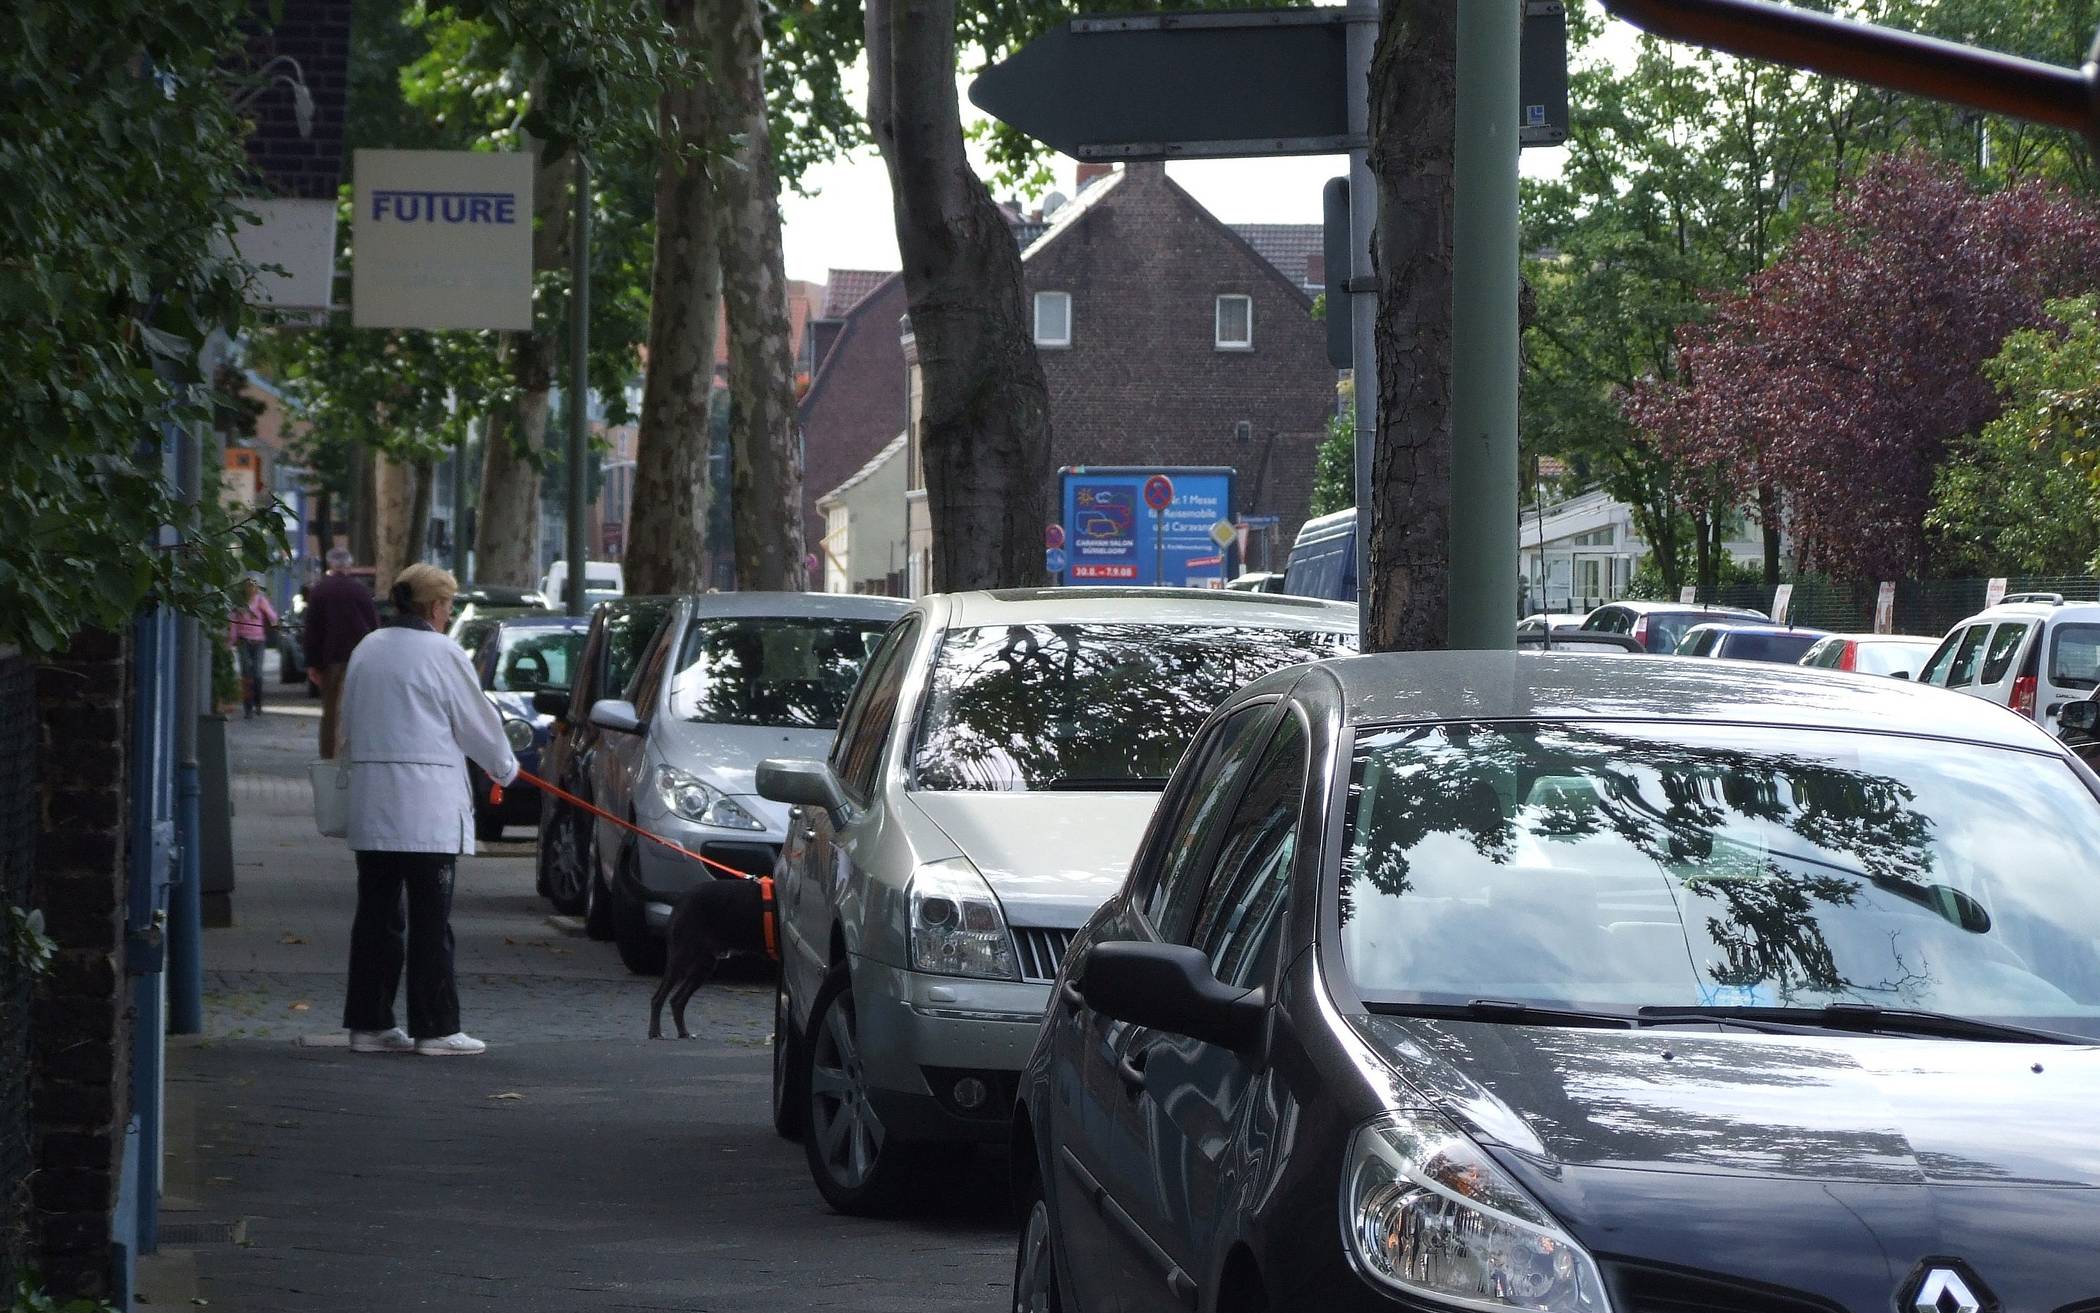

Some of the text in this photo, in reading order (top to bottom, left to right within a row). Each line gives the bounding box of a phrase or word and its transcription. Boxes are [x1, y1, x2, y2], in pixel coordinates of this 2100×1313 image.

[371, 190, 515, 224] FUTURE
[1189, 495, 1217, 505] Messe
[1153, 521, 1169, 532] ud
